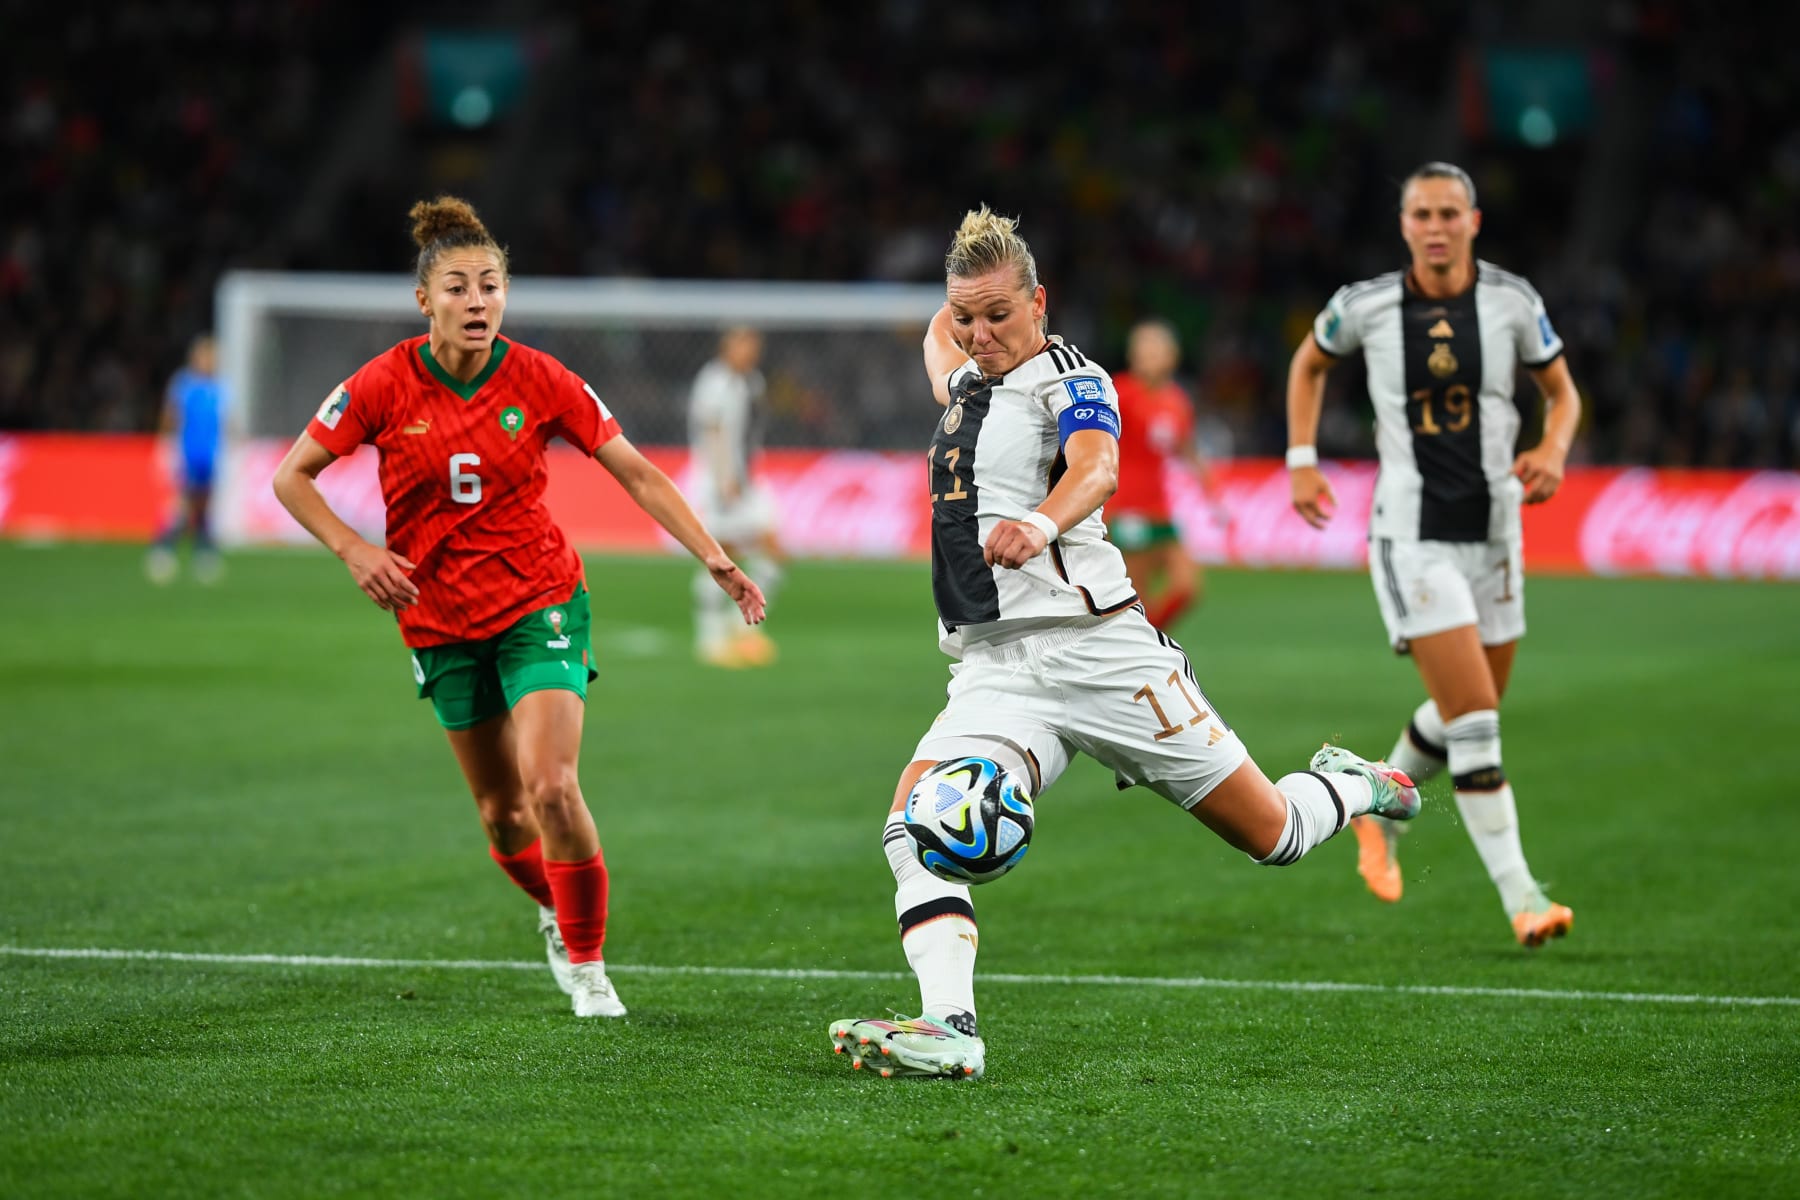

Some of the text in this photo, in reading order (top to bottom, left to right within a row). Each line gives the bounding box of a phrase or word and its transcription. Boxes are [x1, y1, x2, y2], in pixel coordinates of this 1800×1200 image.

[1412, 384, 1471, 433] 19
[450, 453, 482, 504] 6
[1133, 669, 1210, 742] 11
